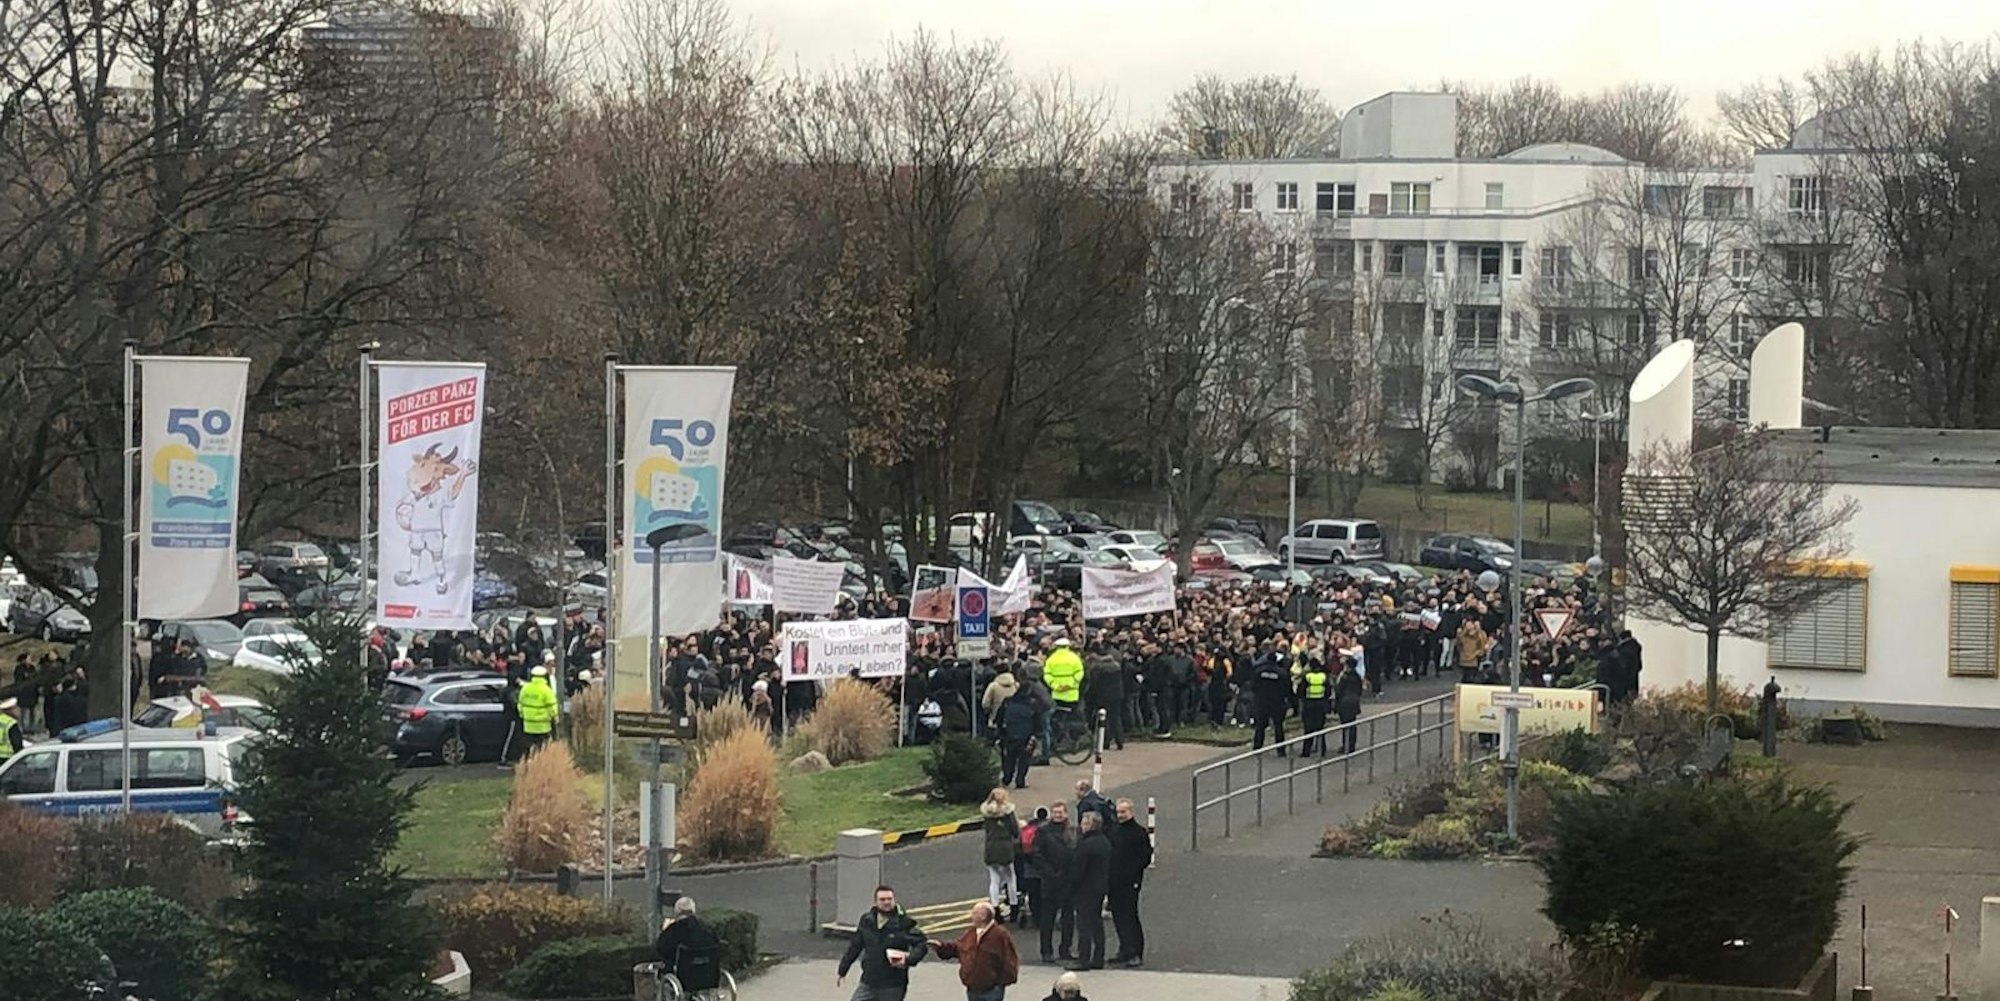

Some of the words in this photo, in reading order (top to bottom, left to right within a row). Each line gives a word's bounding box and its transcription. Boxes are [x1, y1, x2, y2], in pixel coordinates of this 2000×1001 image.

[389, 391, 438, 416] PORZER
[167, 408, 231, 449] 50
[422, 411, 450, 432] DER
[454, 404, 473, 424] FC
[650, 419, 715, 461] 50
[881, 621, 901, 635] und
[964, 622, 985, 633] TAXI
[814, 661, 833, 675] Als
